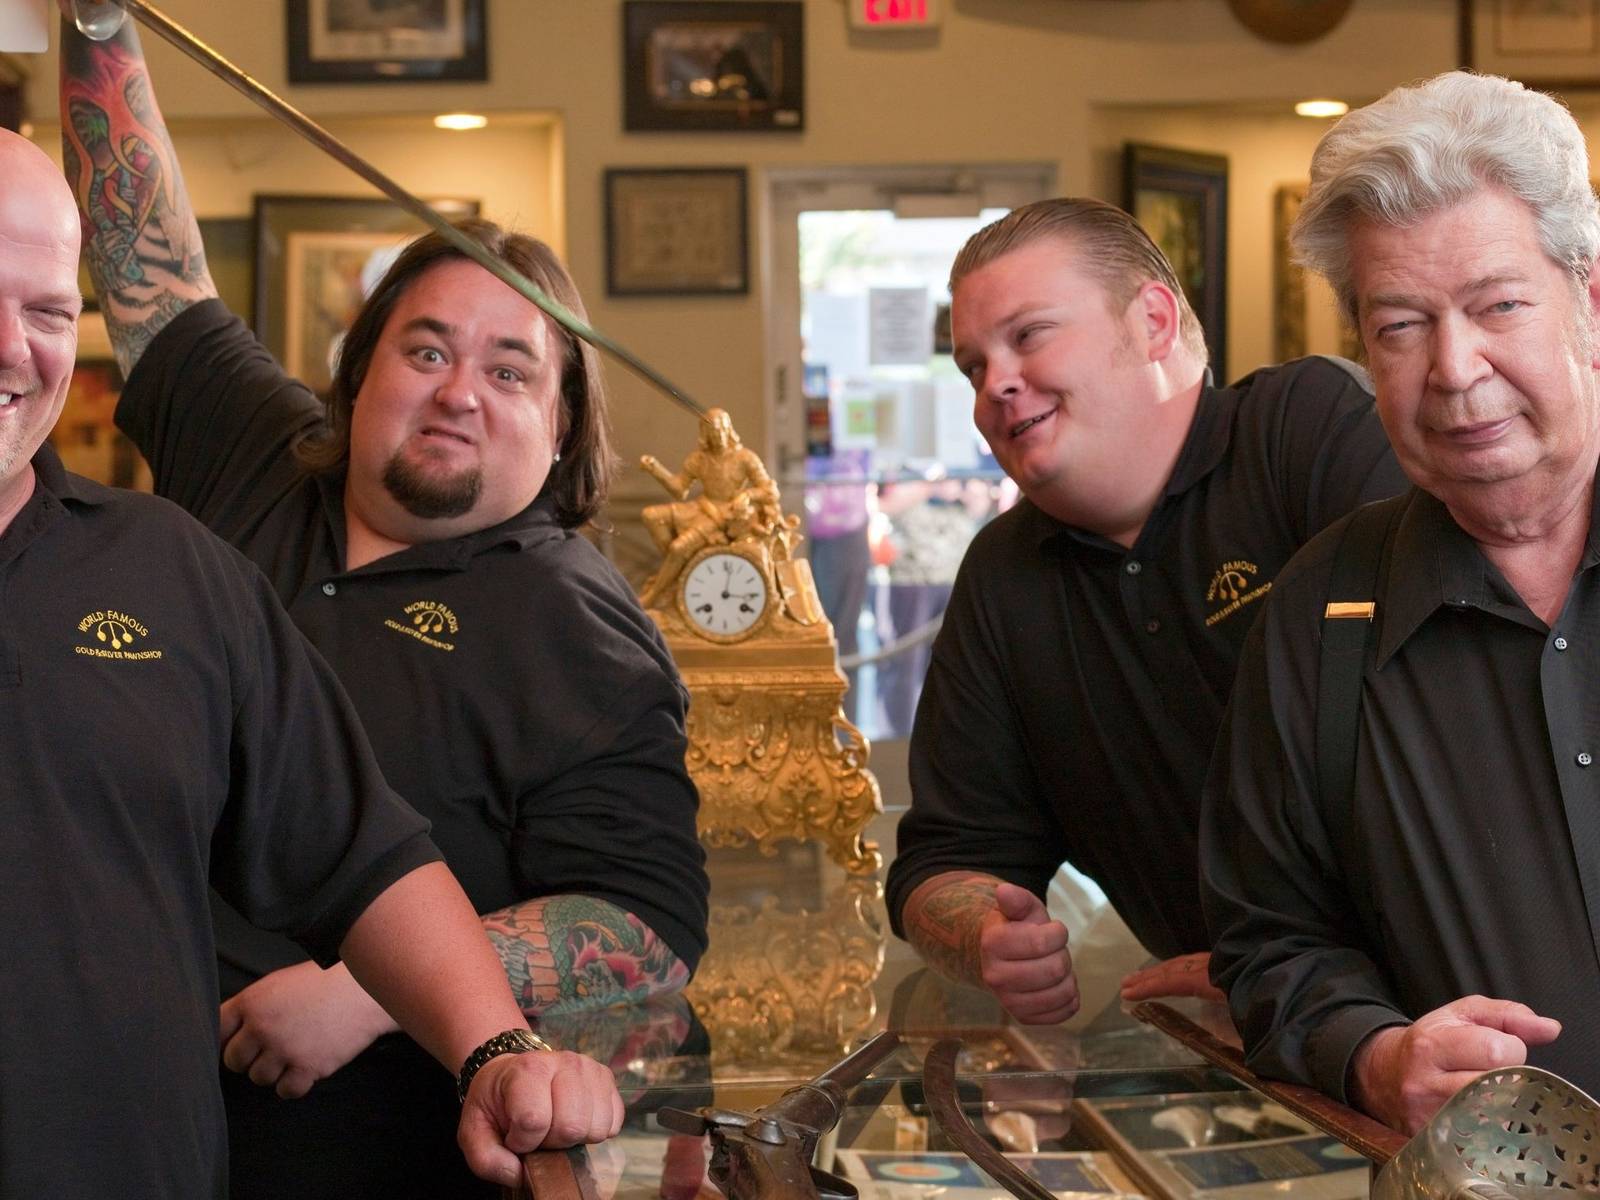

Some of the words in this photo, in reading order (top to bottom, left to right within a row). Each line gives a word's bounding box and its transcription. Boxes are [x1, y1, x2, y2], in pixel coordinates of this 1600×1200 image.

[1223, 560, 1258, 575] FAMOUS
[404, 601, 436, 614] WORLD
[78, 611, 104, 632] WORLD
[107, 610, 149, 637] FAMOUS
